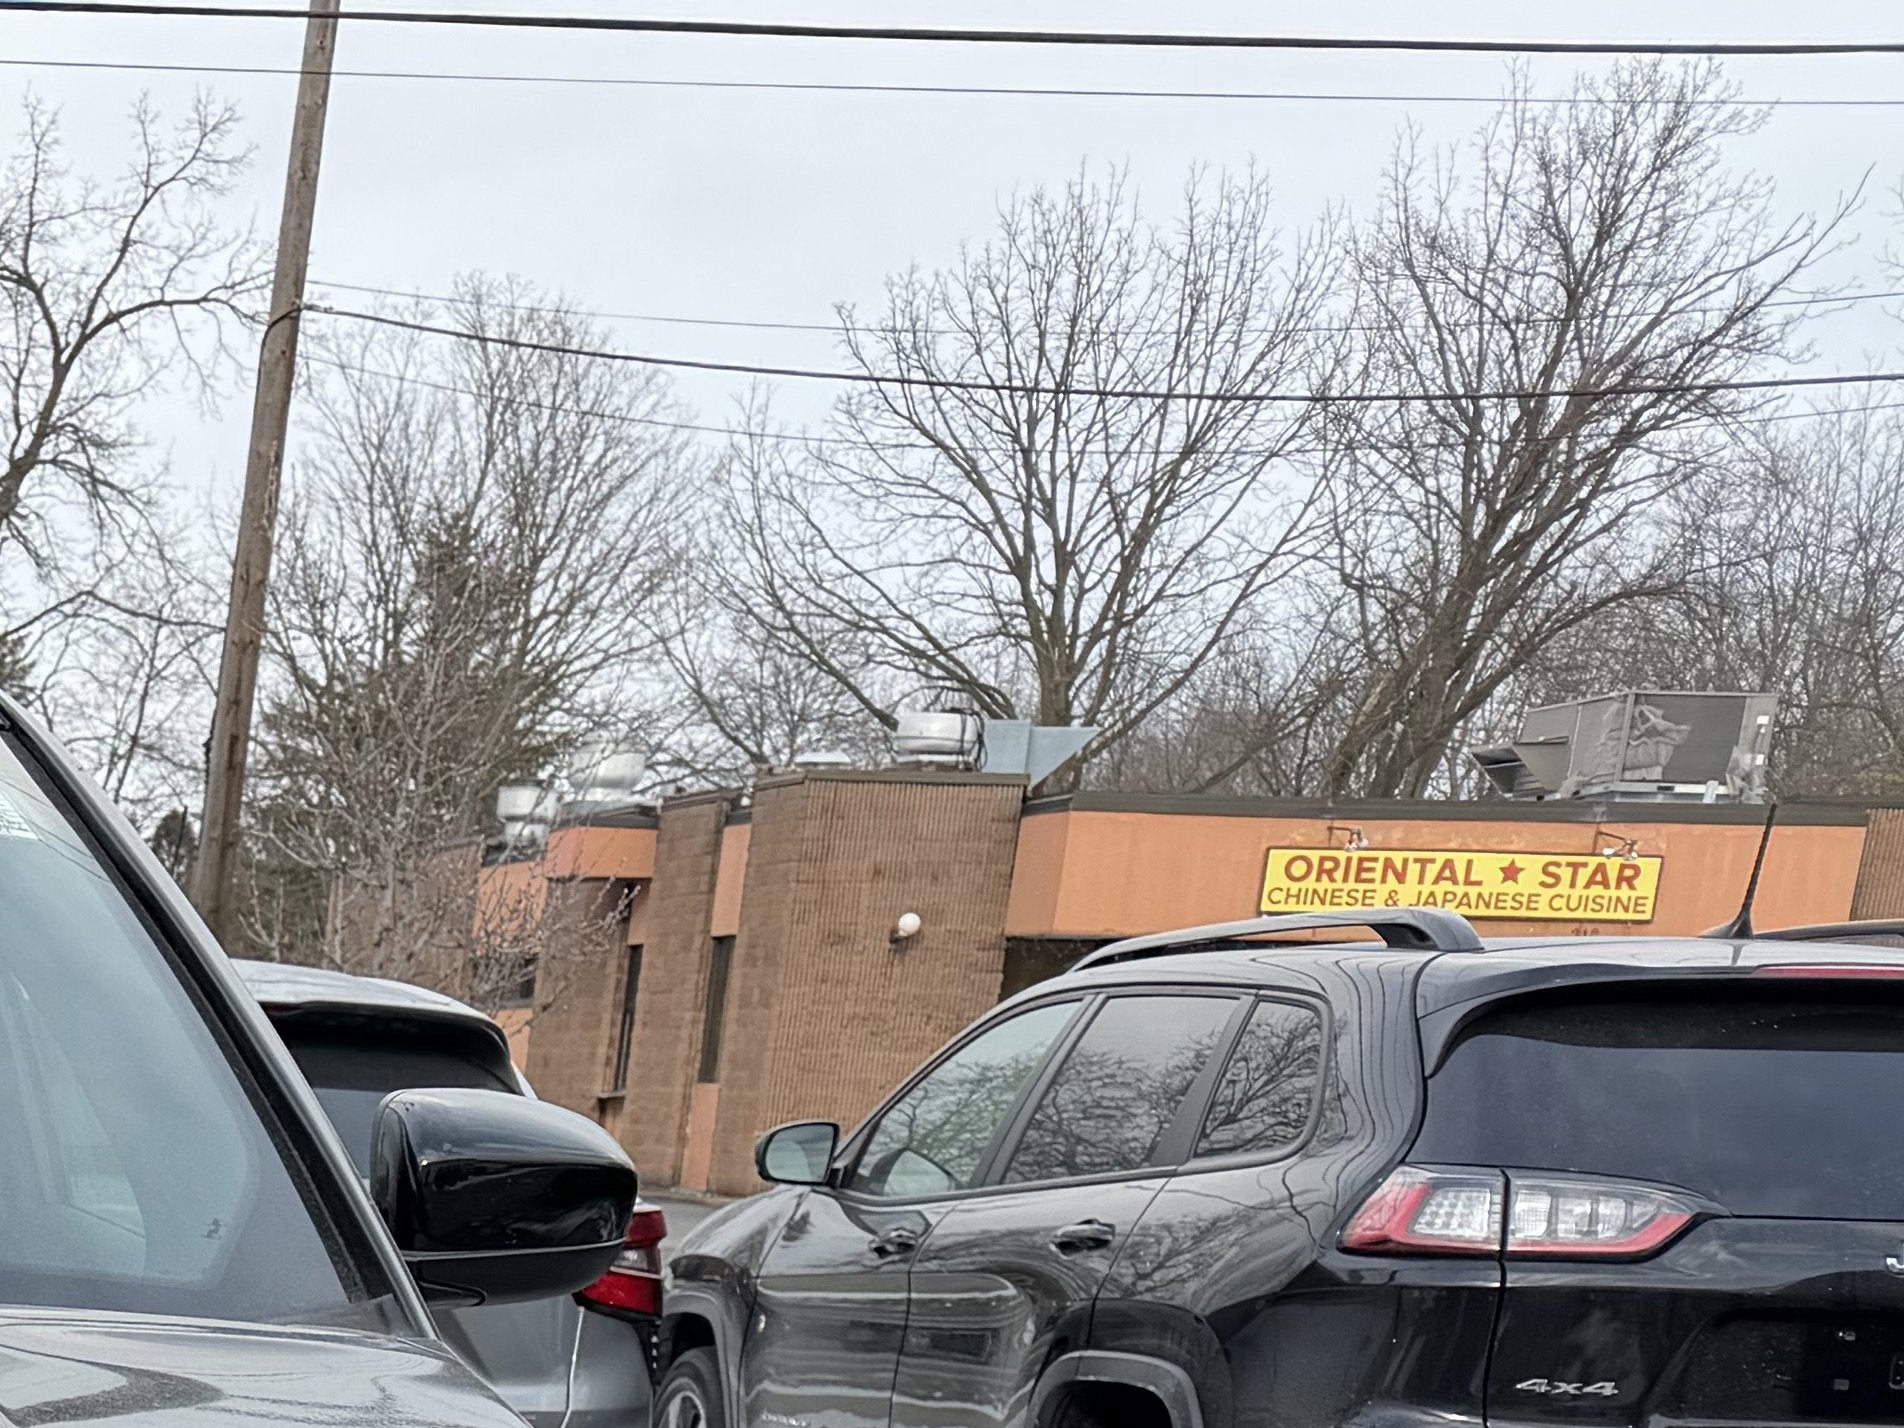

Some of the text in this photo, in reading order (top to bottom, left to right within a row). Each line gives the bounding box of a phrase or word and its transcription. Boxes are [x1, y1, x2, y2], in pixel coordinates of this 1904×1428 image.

[1284, 854, 1642, 891] ORIENTAL STAR
[1267, 887, 1649, 914] CHINESE & JAPANESE CUISINE
[1516, 1379, 1619, 1396] 4x4
